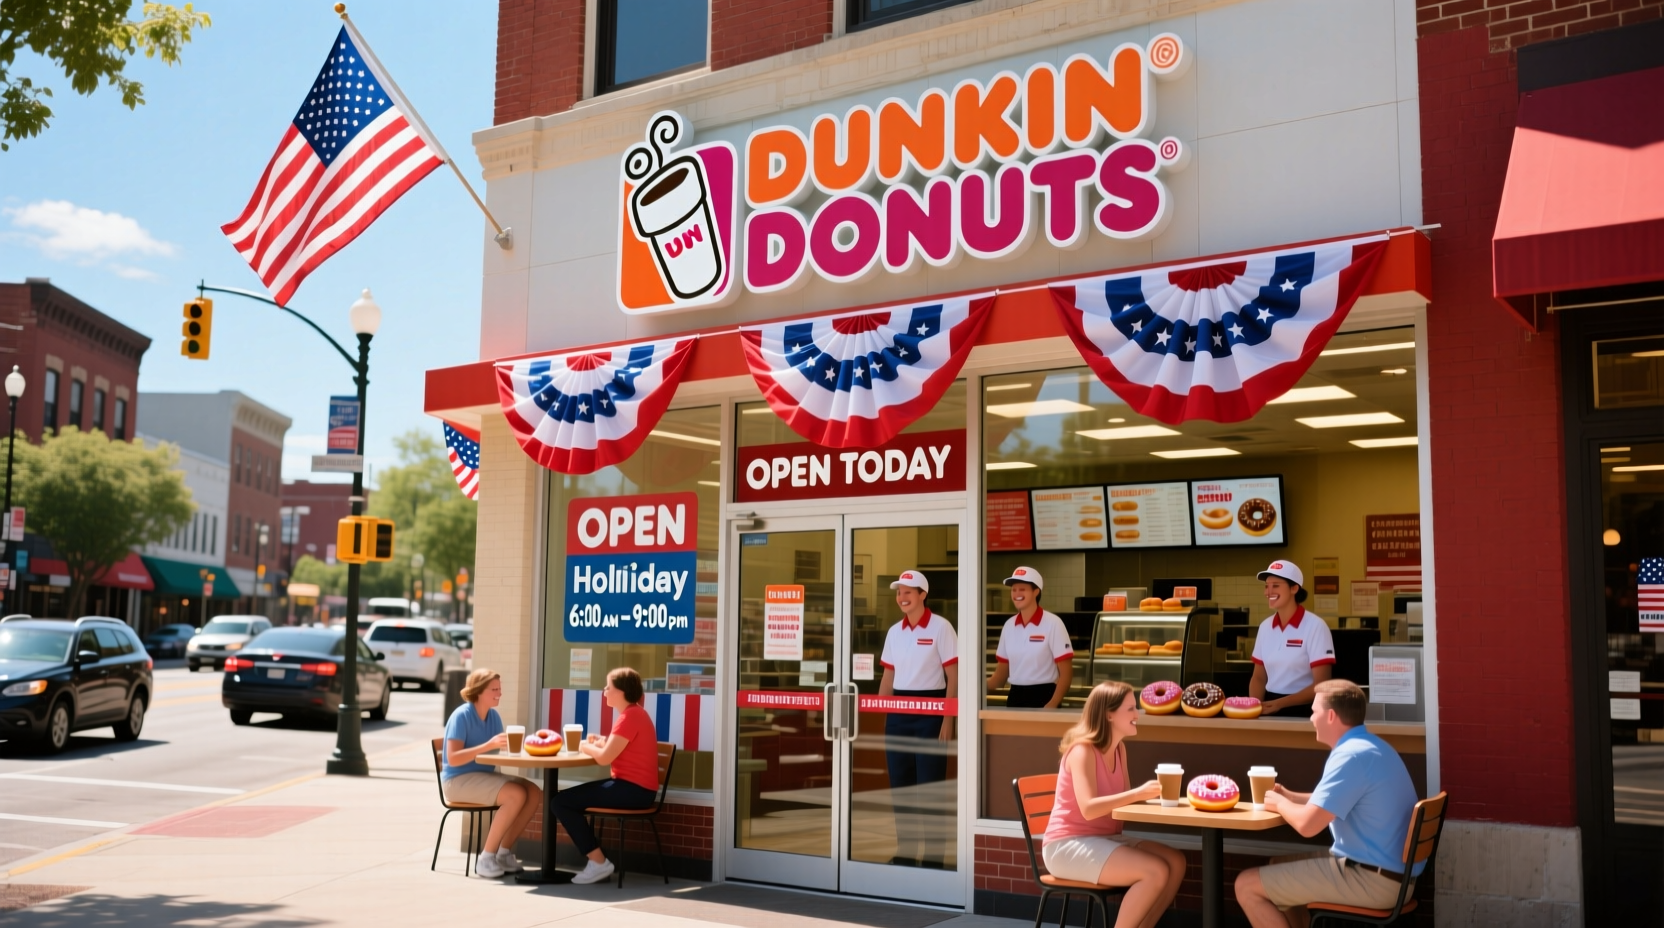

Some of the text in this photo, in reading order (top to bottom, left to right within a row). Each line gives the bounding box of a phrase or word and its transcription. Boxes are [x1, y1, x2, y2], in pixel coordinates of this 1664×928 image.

[747, 42, 1143, 204] DUNKIN
[746, 143, 1160, 289] DONUTS
[746, 444, 951, 490] OPEN TODAY
[577, 503, 686, 548] OPEN
